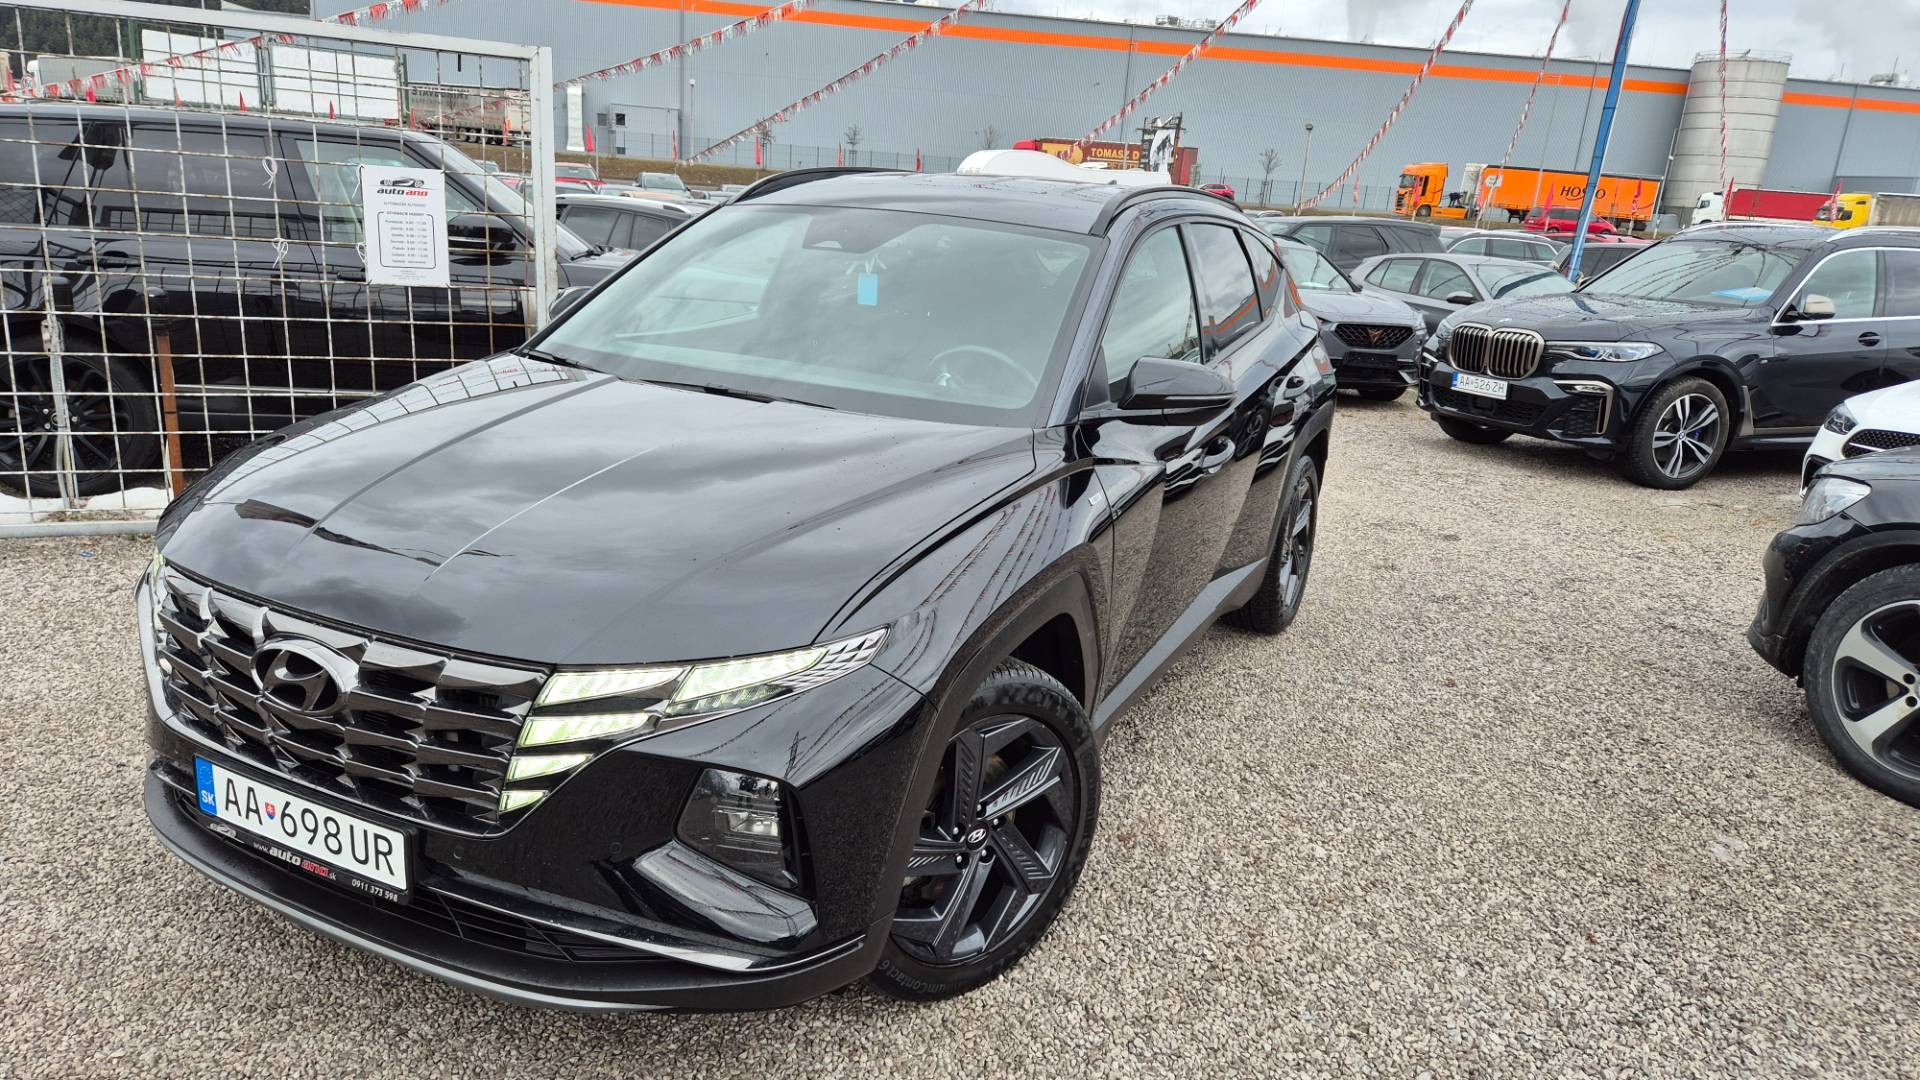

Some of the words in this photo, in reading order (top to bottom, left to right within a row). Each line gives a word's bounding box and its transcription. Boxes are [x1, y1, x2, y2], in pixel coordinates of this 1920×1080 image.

[377, 188, 404, 196] auto
[201, 789, 216, 807] SK
[351, 877, 369, 892] 0911
[369, 885, 384, 898] 373
[384, 890, 399, 903] 598
